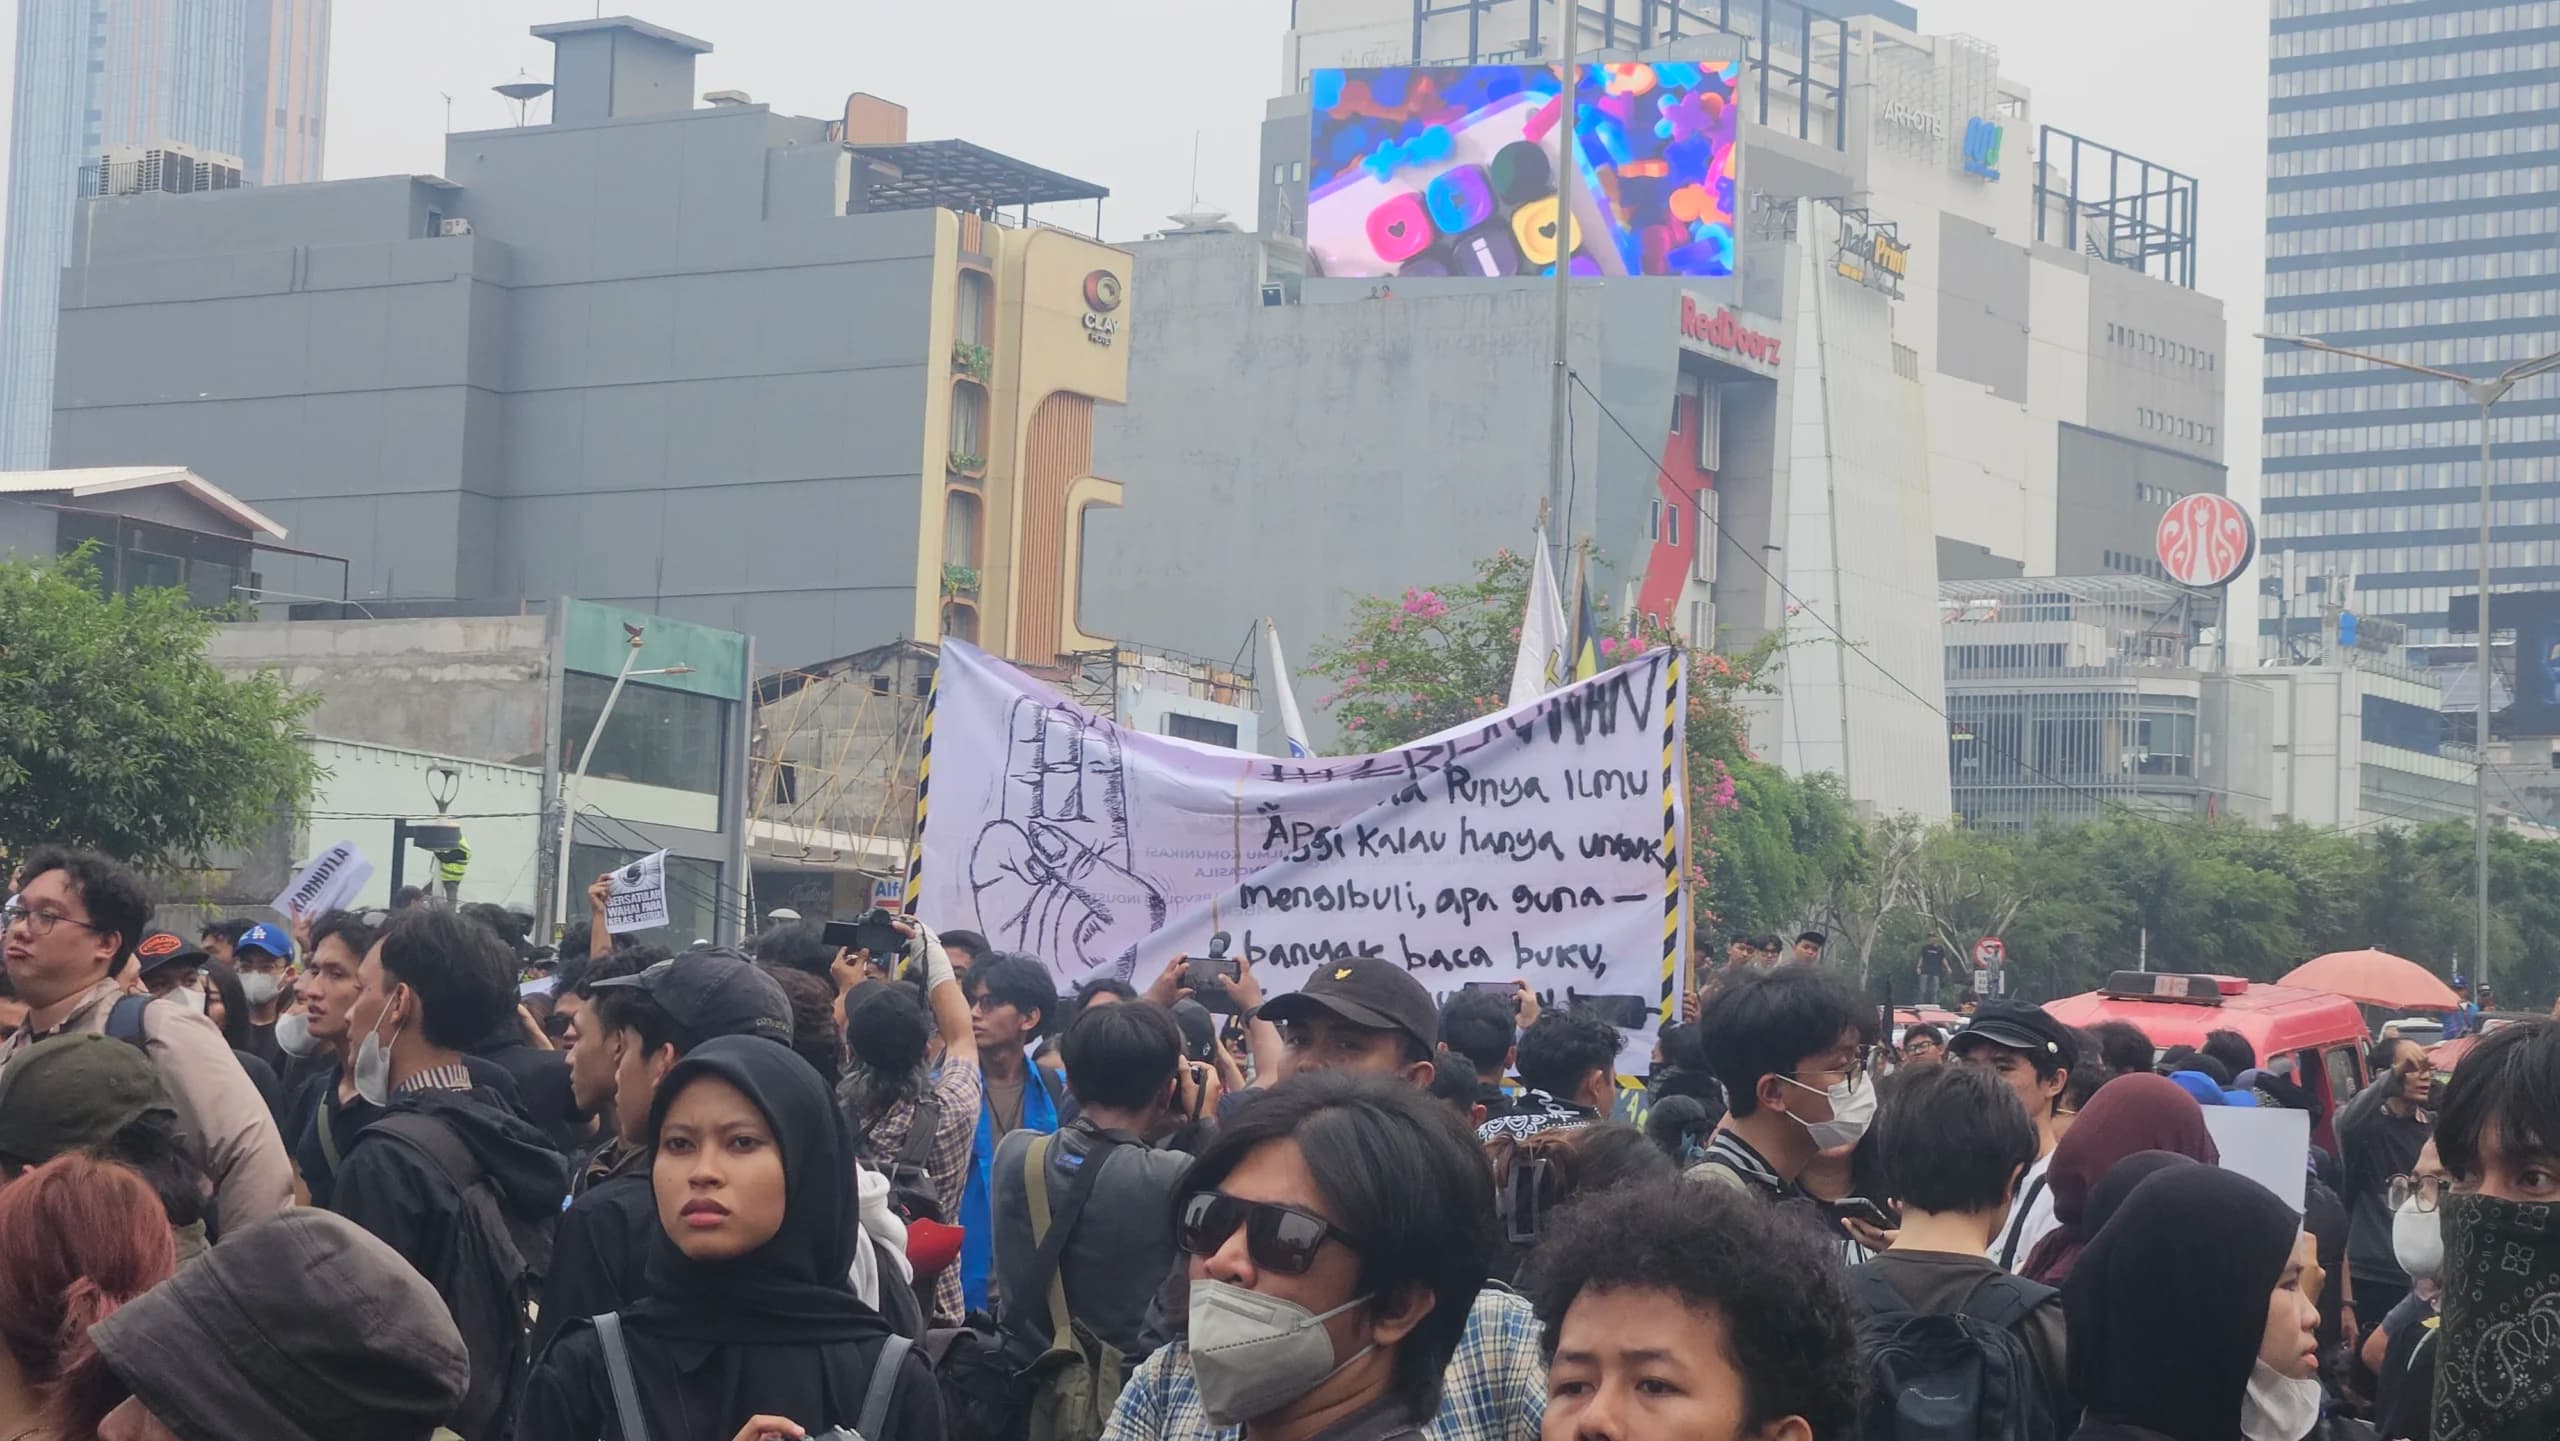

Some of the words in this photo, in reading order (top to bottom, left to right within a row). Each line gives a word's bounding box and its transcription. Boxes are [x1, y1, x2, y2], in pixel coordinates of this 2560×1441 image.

[1681, 294, 1781, 366] RedDoorz
[289, 847, 350, 913] KARHUTLA
[875, 881, 899, 897] Alf
[606, 902, 640, 918] WAHAI
[1399, 933, 1493, 972] baca
